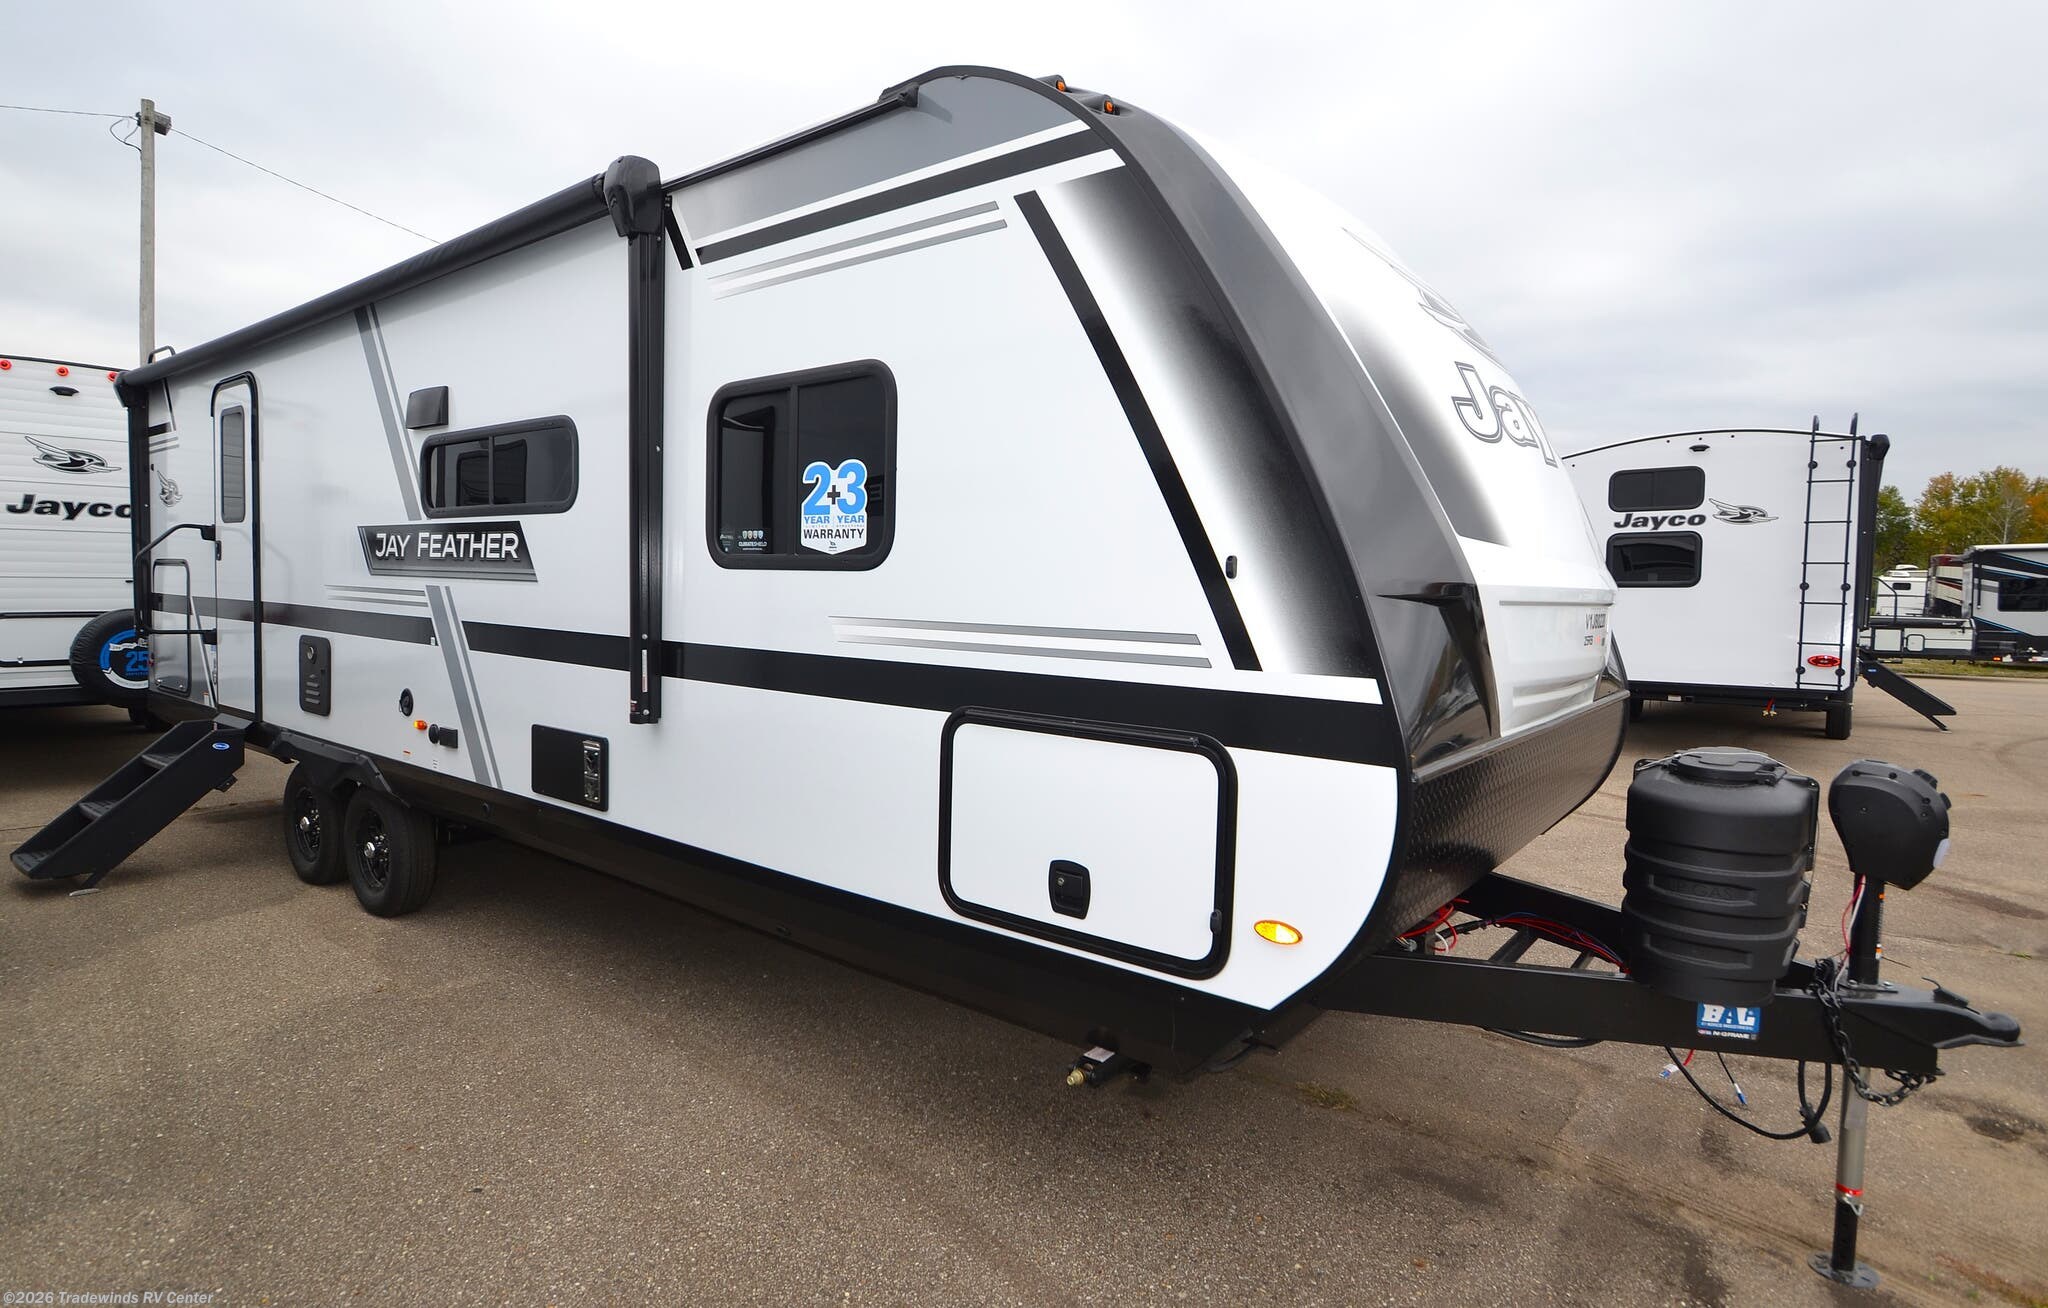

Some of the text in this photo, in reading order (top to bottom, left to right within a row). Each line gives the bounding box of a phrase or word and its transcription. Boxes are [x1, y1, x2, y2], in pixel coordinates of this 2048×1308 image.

[804, 515, 865, 524] YEAR YEAR
[1614, 513, 1707, 531] Jayco
[803, 529, 864, 539] WARRANTY
[375, 532, 519, 559] JAY FEATHER
[1702, 1003, 1756, 1026] BAL
